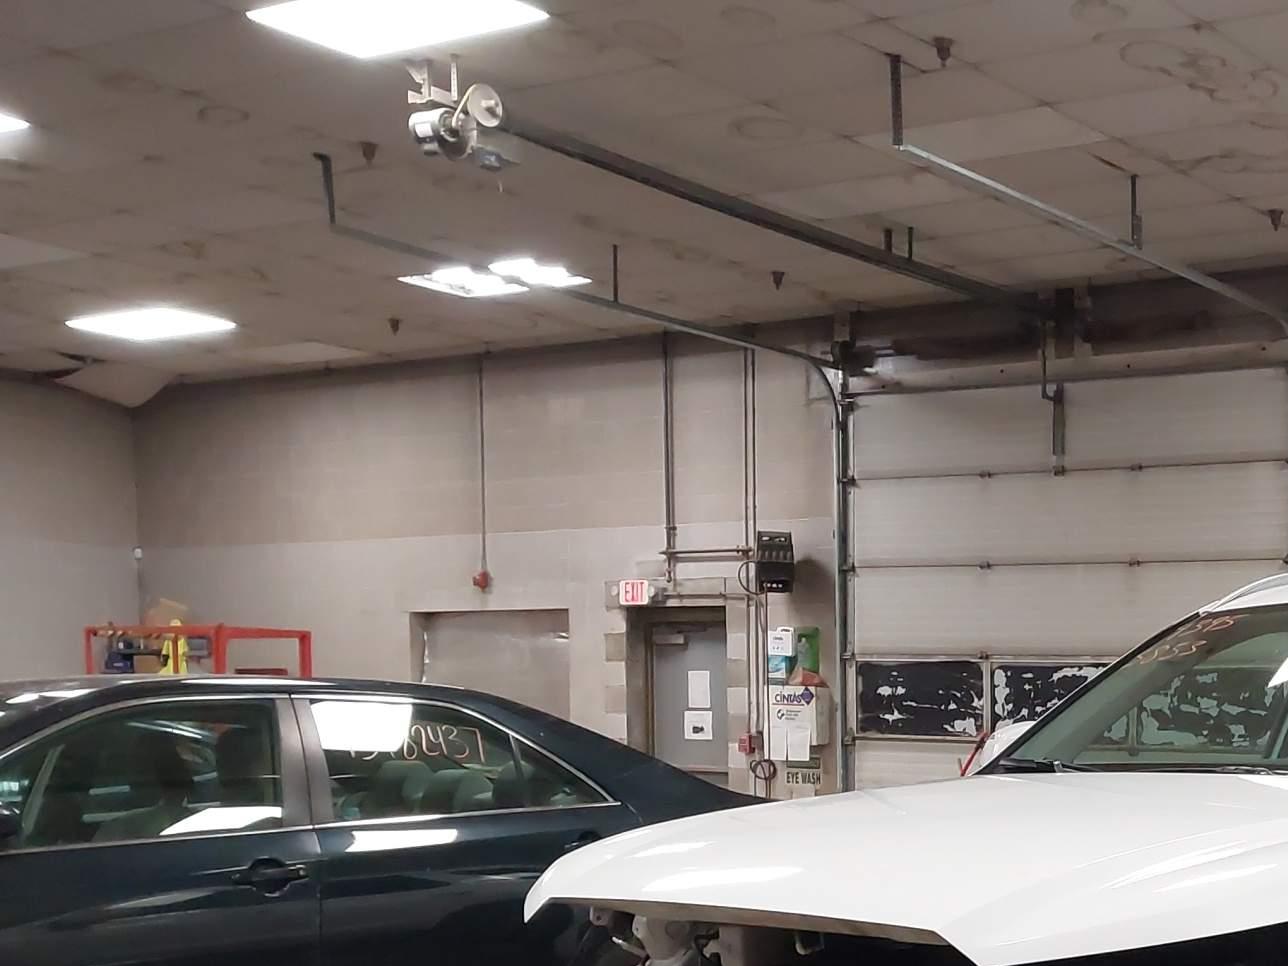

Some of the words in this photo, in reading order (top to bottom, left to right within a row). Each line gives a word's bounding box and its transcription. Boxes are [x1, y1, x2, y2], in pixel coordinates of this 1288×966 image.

[624, 581, 645, 602] EXIT
[786, 771, 800, 784] EYE
[801, 771, 821, 785] WASH
